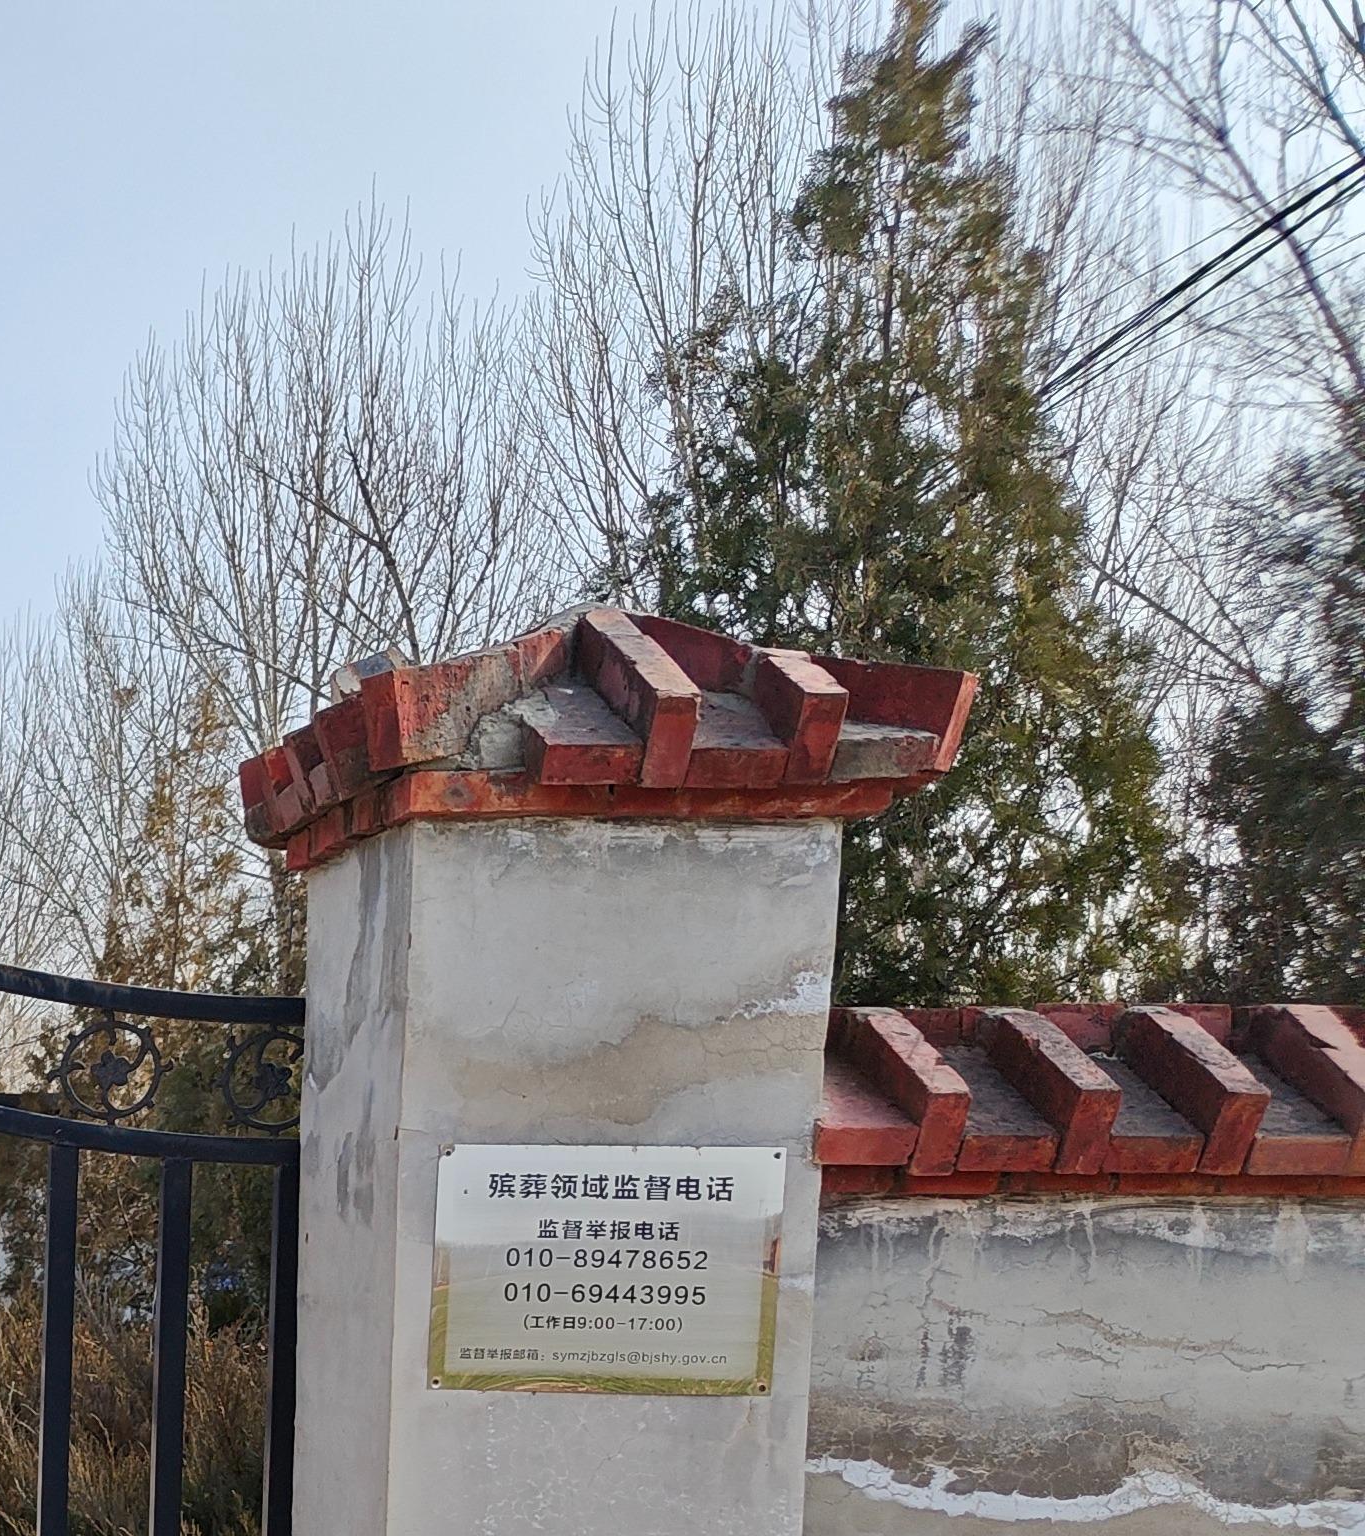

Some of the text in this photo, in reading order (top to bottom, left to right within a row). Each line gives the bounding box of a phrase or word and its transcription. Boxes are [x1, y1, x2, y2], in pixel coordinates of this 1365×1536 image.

[488, 1172, 735, 1203] 殡葬领域监督电话
[537, 1219, 681, 1242] 监督举报电话
[506, 1247, 709, 1271] 010-89478652
[503, 1282, 707, 1306] 010-69443995
